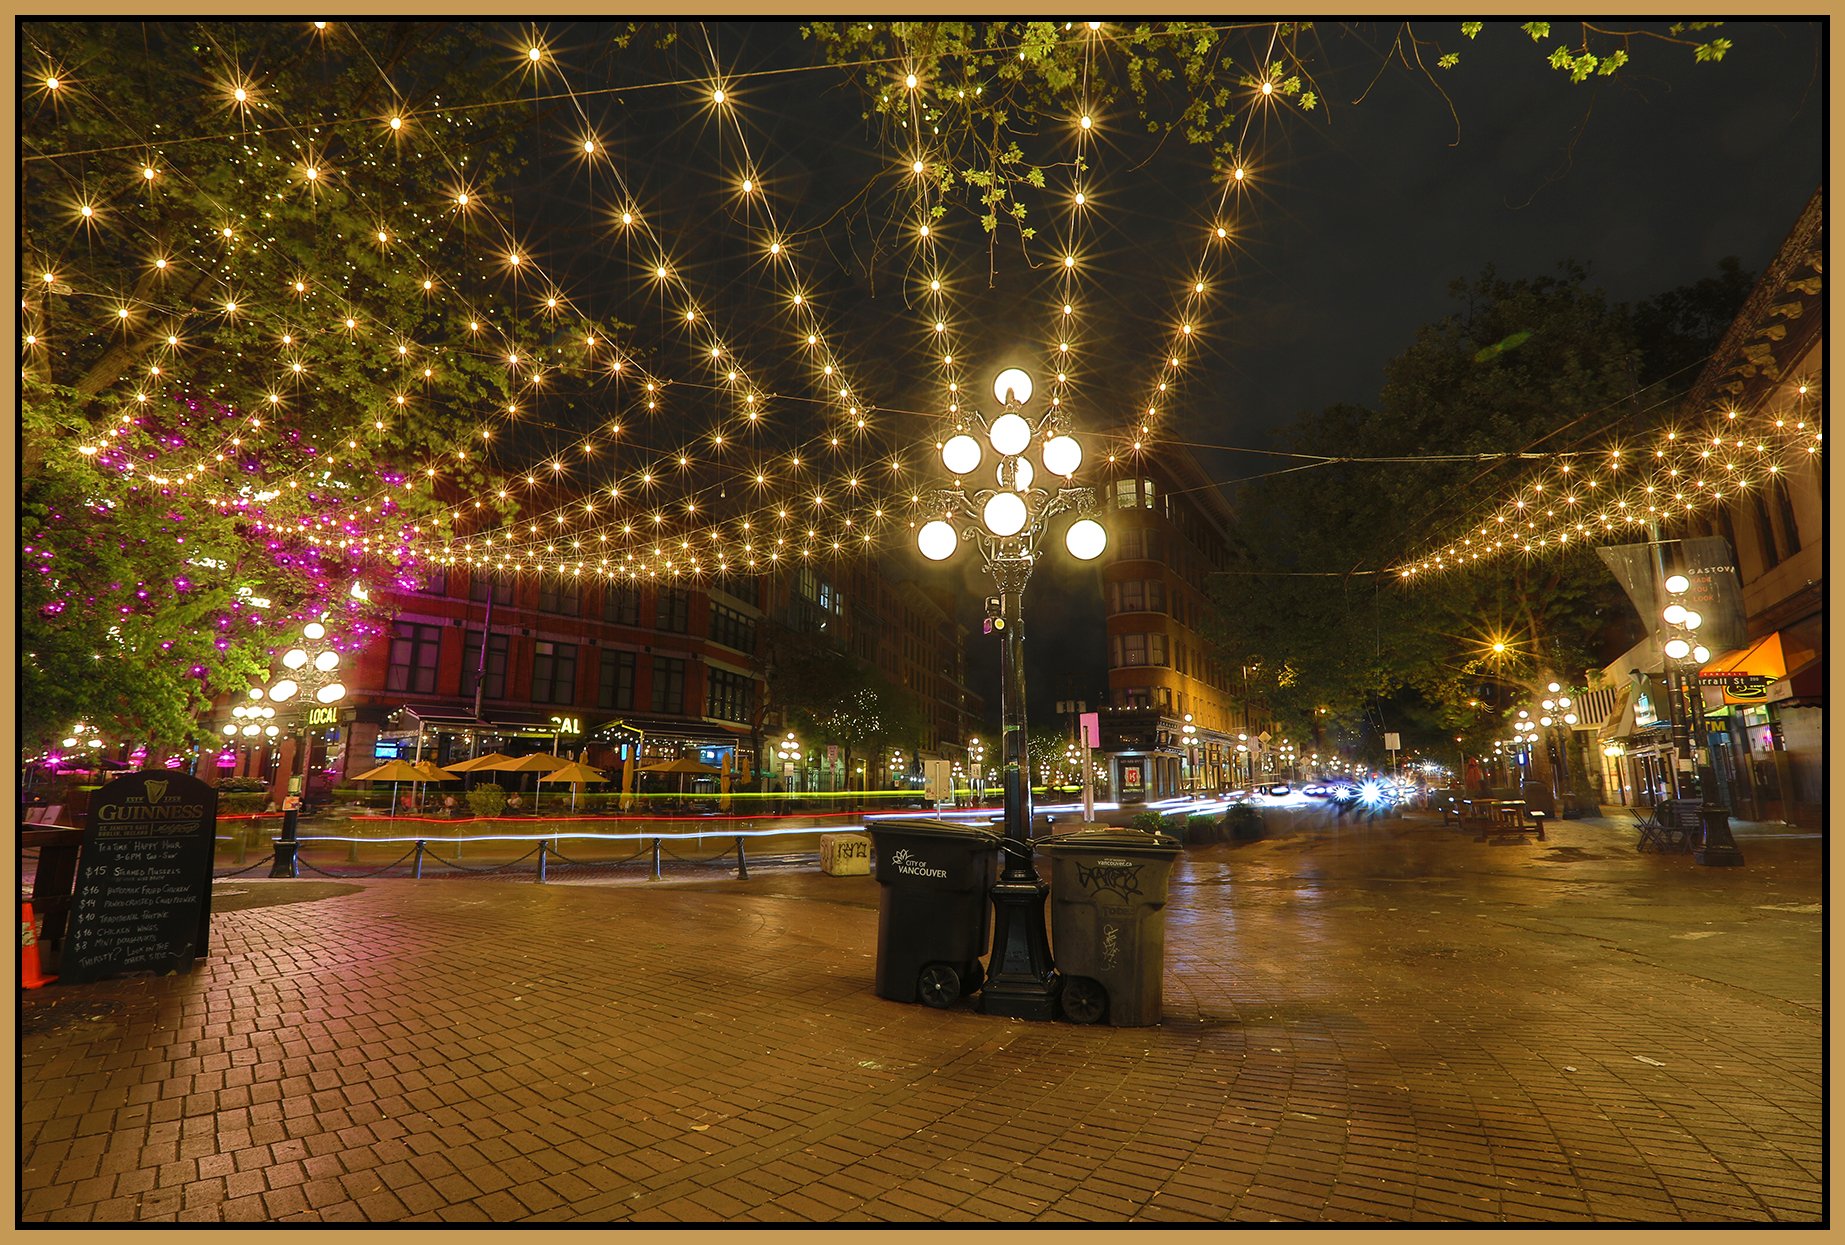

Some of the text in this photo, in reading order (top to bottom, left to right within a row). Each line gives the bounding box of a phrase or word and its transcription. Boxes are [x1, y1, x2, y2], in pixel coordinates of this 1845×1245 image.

[1733, 677, 1745, 685] St
[309, 706, 338, 725] LOCAL
[97, 803, 204, 821] GUINNESS
[905, 859, 918, 867] CITY
[85, 865, 107, 879] $15
[898, 865, 947, 879] VANCOUVER
[82, 885, 100, 896] $16
